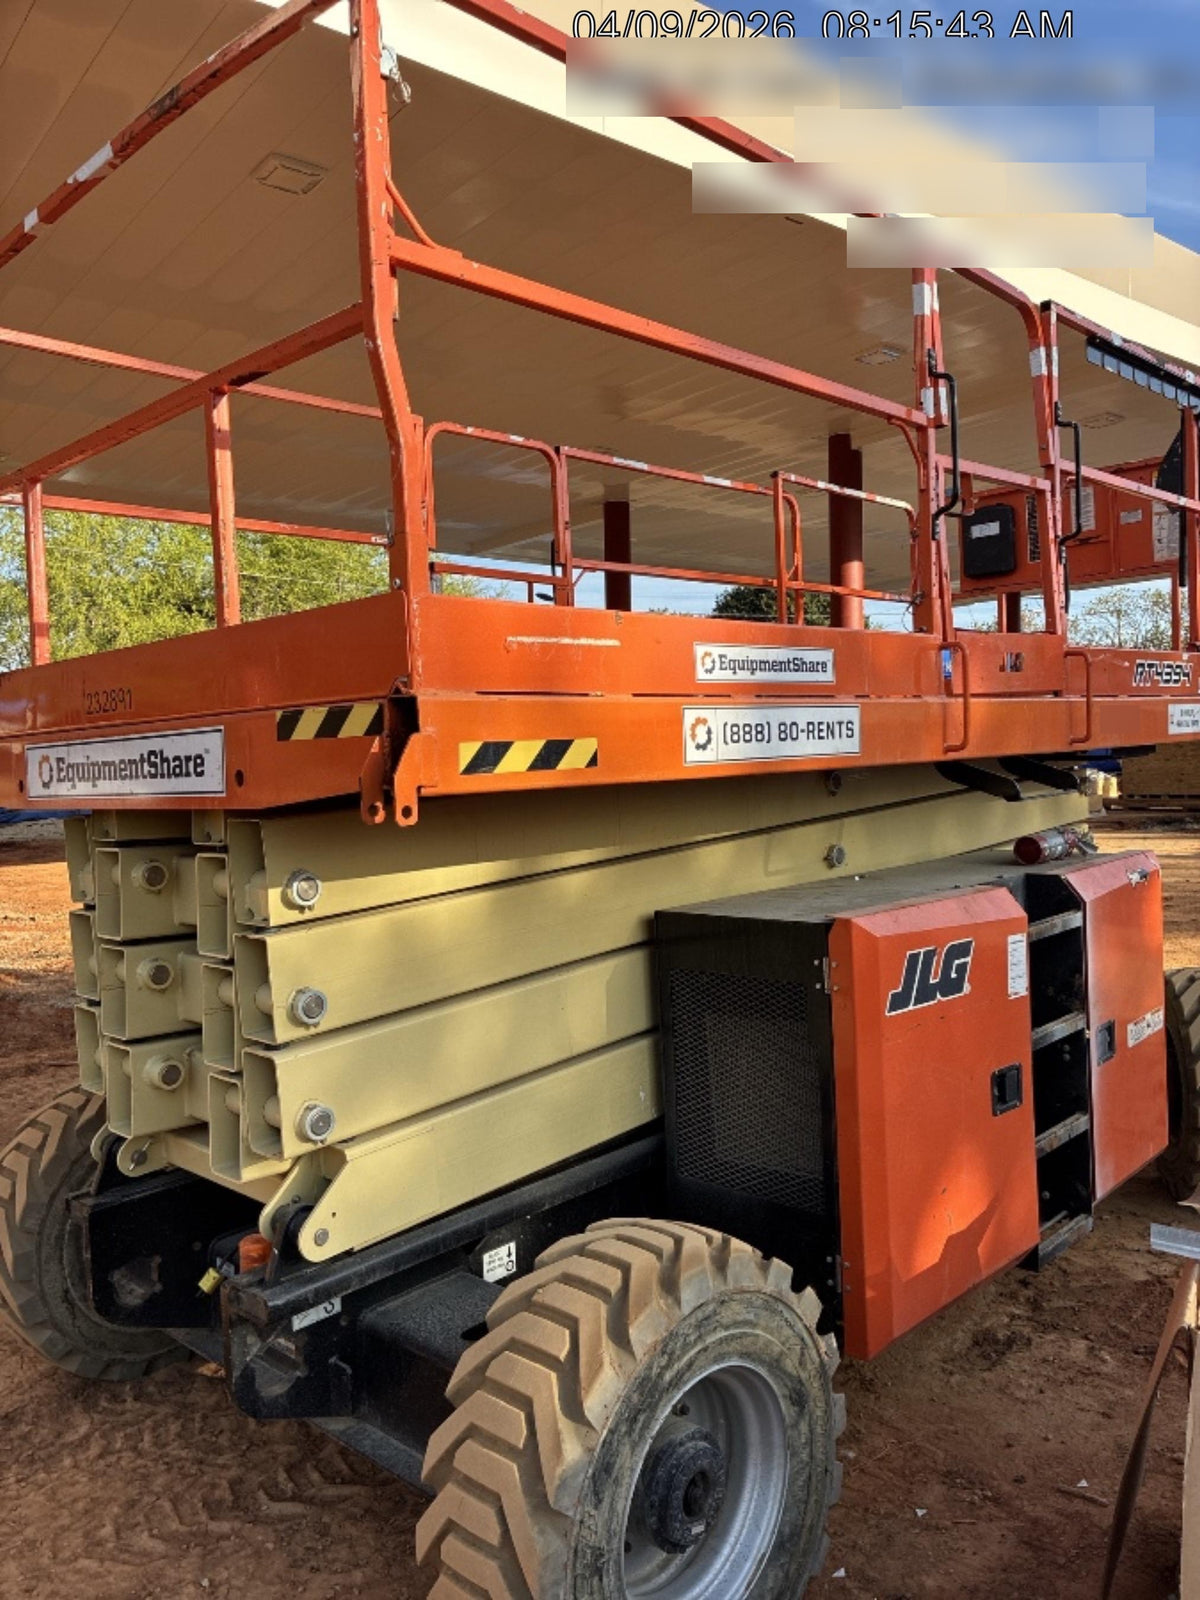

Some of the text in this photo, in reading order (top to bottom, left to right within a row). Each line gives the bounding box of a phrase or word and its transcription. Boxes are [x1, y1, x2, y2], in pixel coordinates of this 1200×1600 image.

[718, 653, 828, 676] EquipmentShare
[1133, 659, 1194, 687] RT4394
[723, 719, 855, 745] (888) 80-RENTS
[55, 748, 206, 791] EquipmentShare
[885, 937, 974, 1016] JLG
